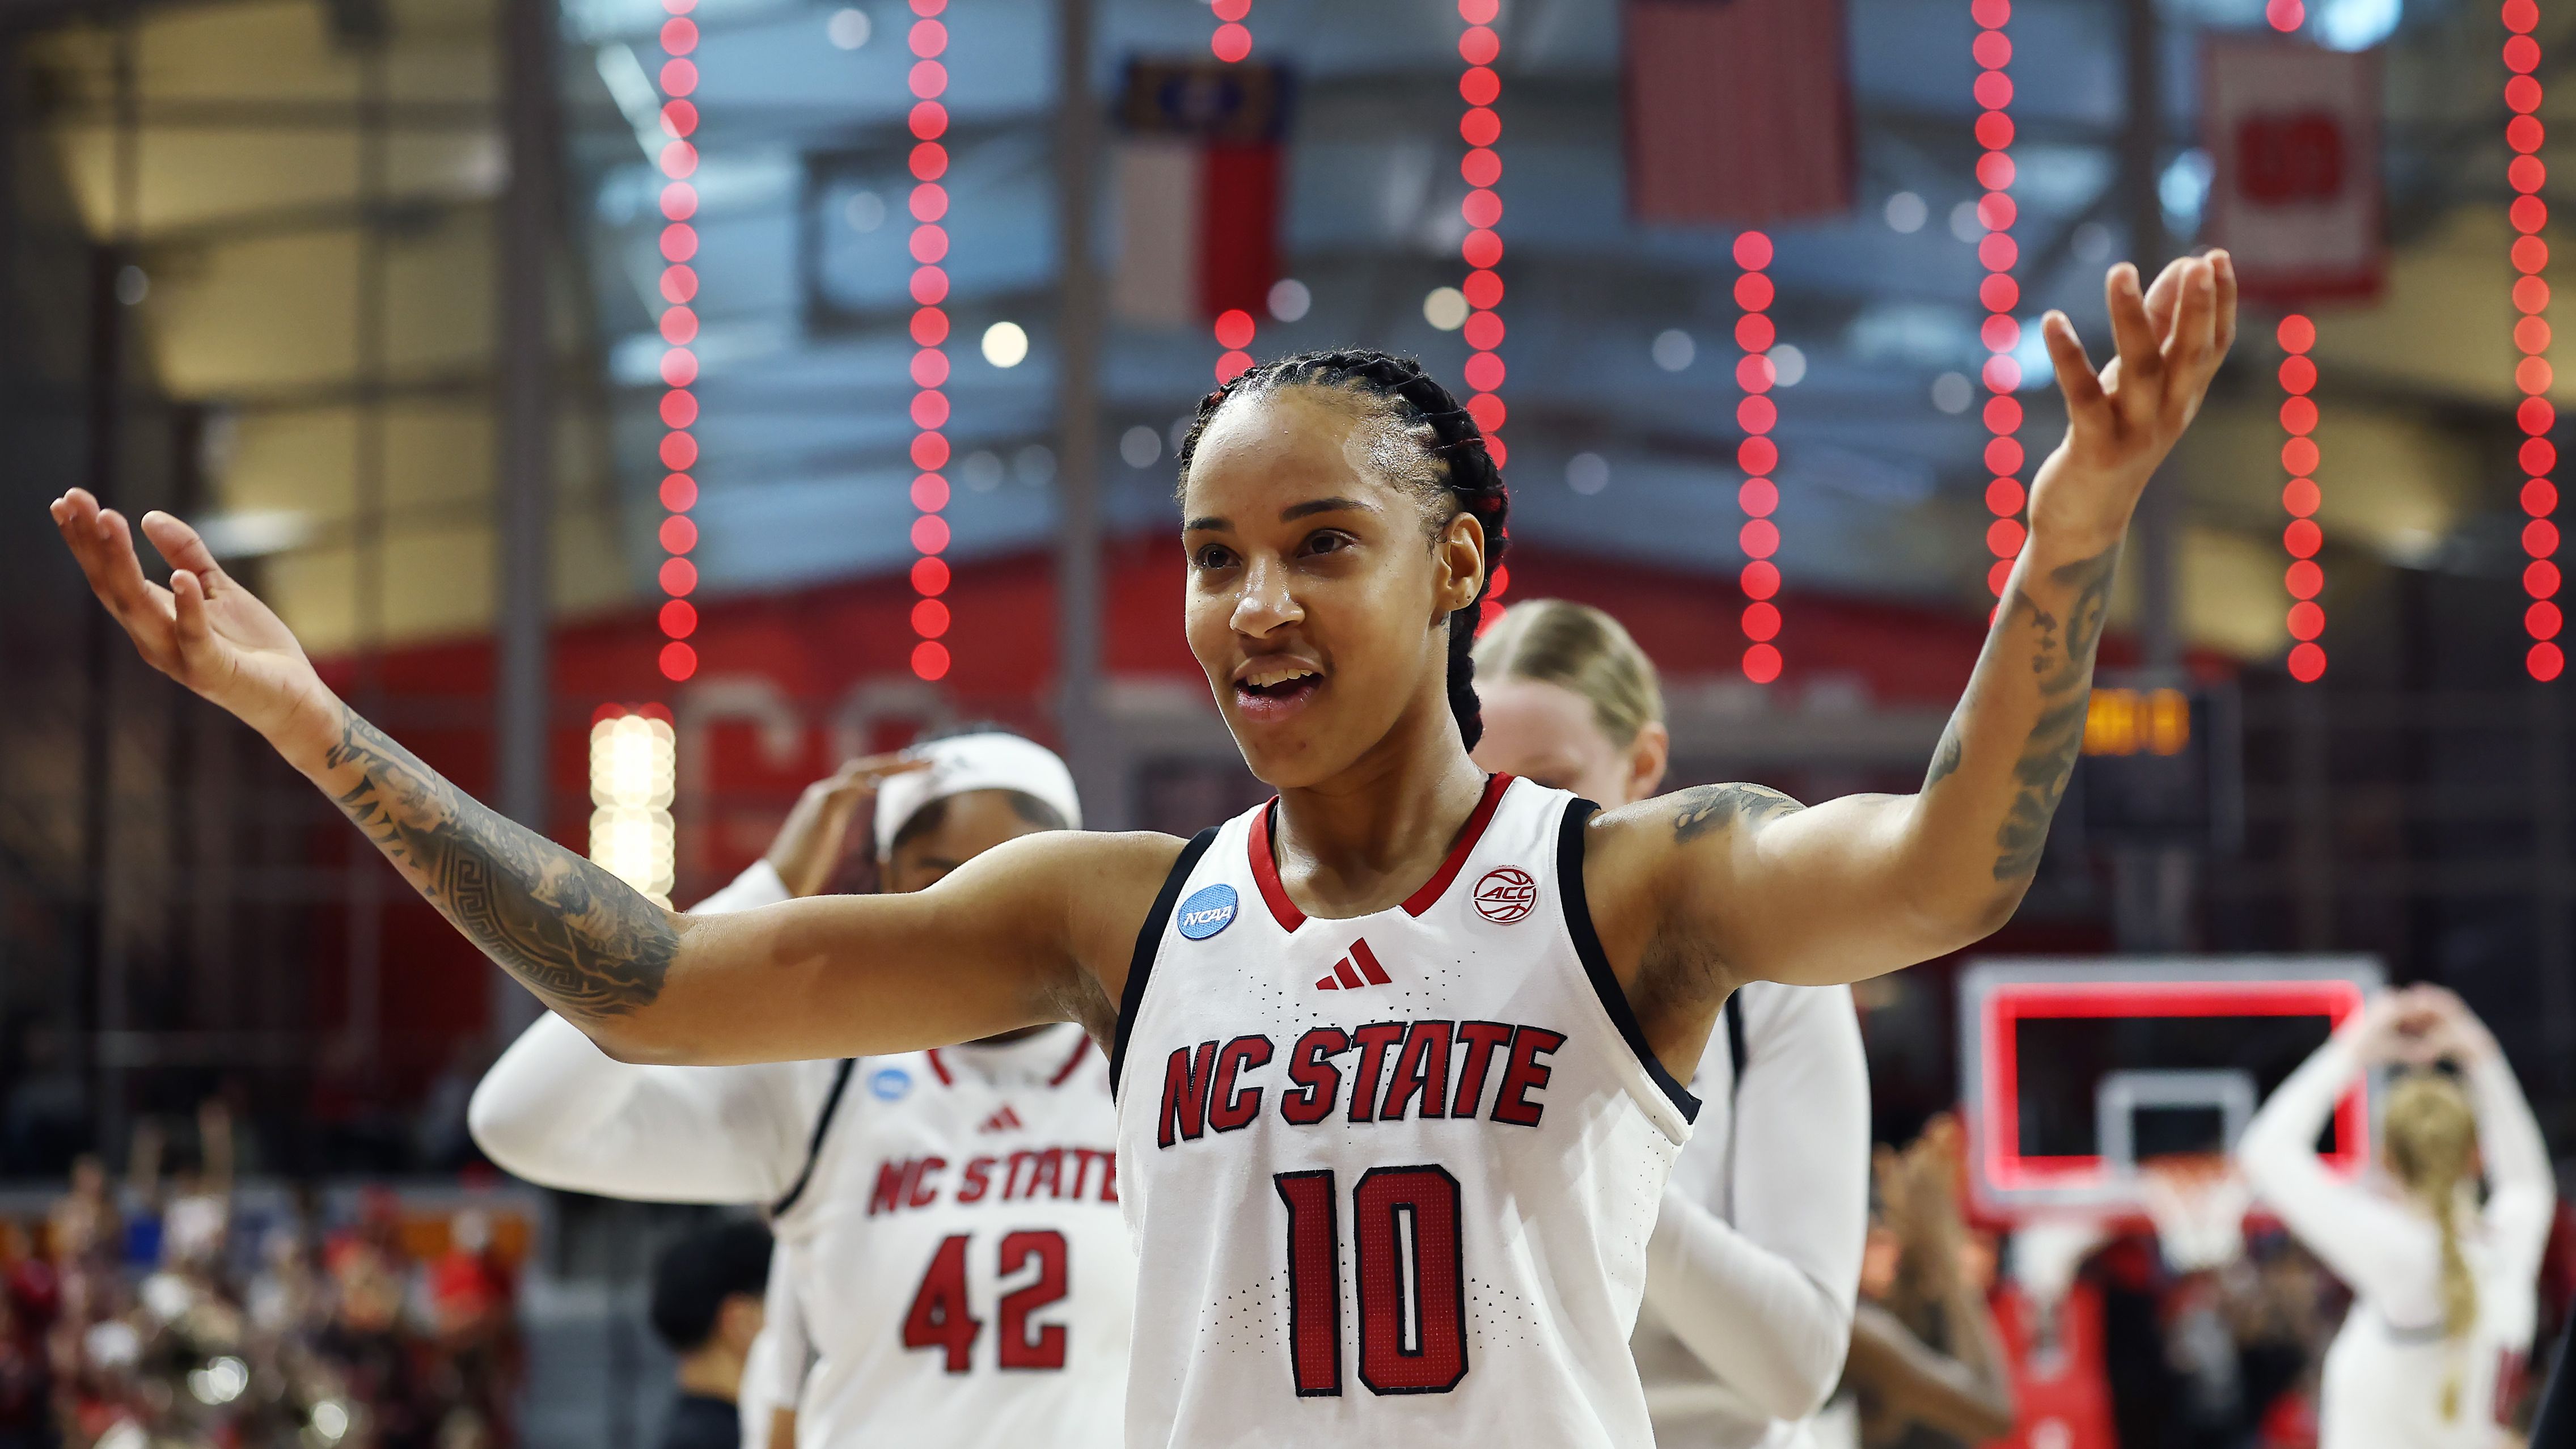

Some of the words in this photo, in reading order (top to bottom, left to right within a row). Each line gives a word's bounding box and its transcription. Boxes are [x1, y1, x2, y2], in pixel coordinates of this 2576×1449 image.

[1183, 905, 1232, 926] NCAA
[1480, 885, 1536, 899] ACC
[1157, 1034, 1275, 1149] NC
[1280, 1020, 1567, 1128] STATE
[867, 1157, 945, 1216] NC
[900, 1230, 1068, 1374] 42
[1273, 1163, 1470, 1399] 10
